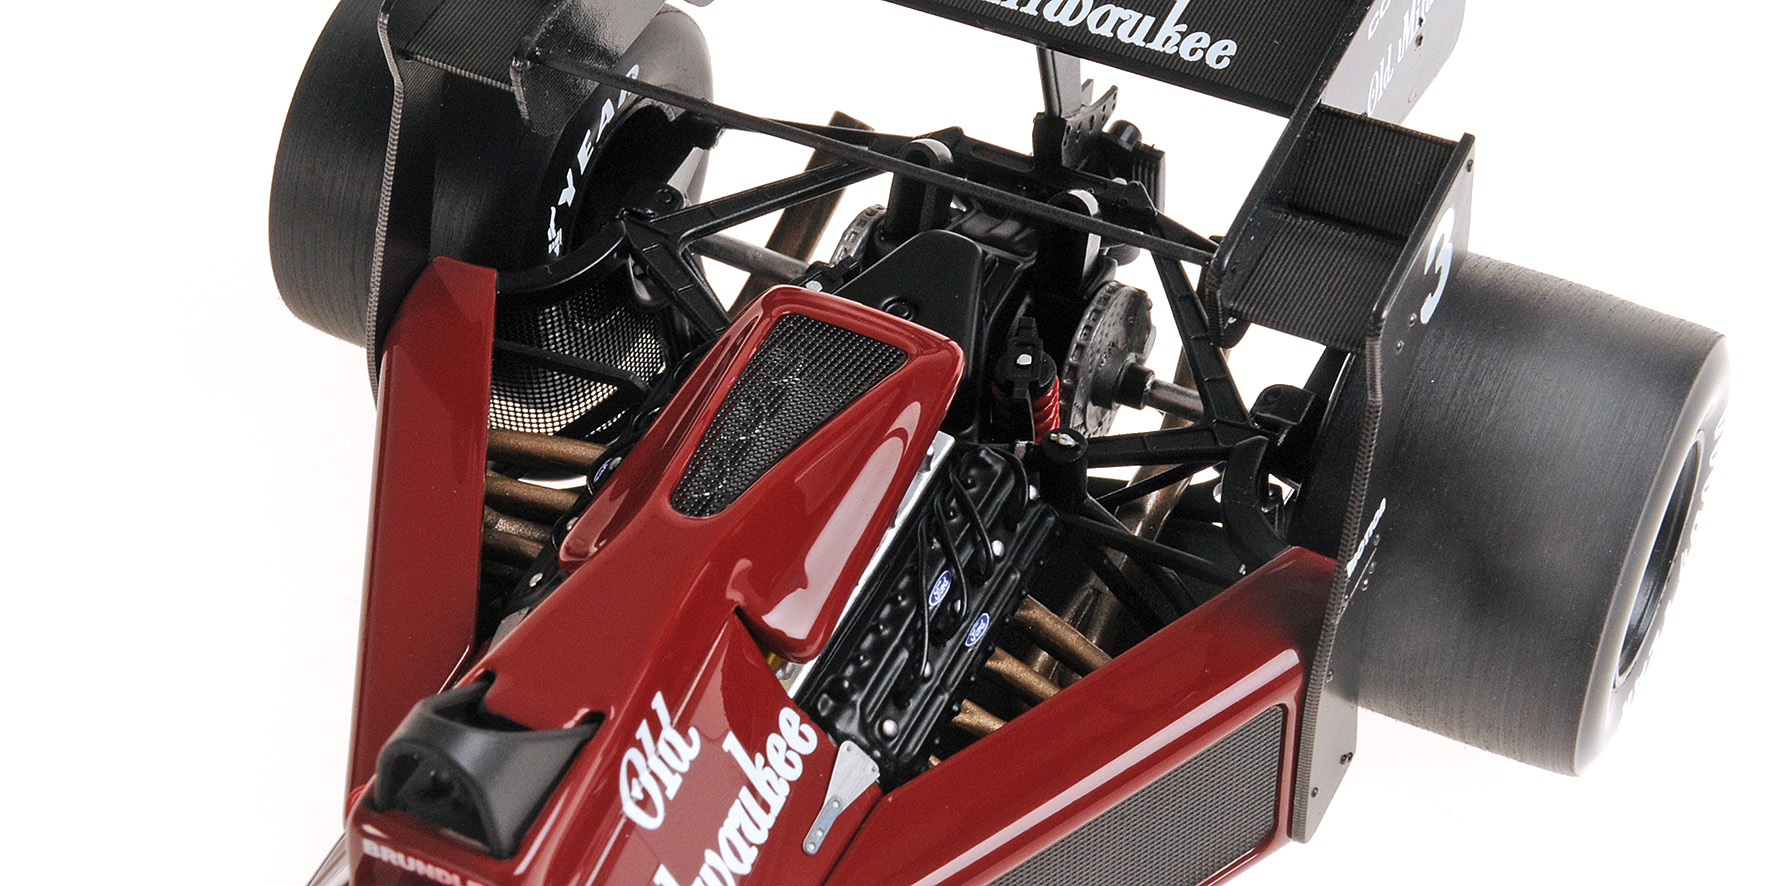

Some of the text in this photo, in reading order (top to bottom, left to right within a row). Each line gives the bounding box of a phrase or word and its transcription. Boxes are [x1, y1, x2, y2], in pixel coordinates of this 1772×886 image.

[985, 0, 1237, 69] waukee
[1367, 42, 1394, 117] Old
[1420, 207, 1455, 324] 3
[931, 573, 950, 603] Ford
[968, 616, 988, 644] Ford
[619, 691, 701, 830] Old
